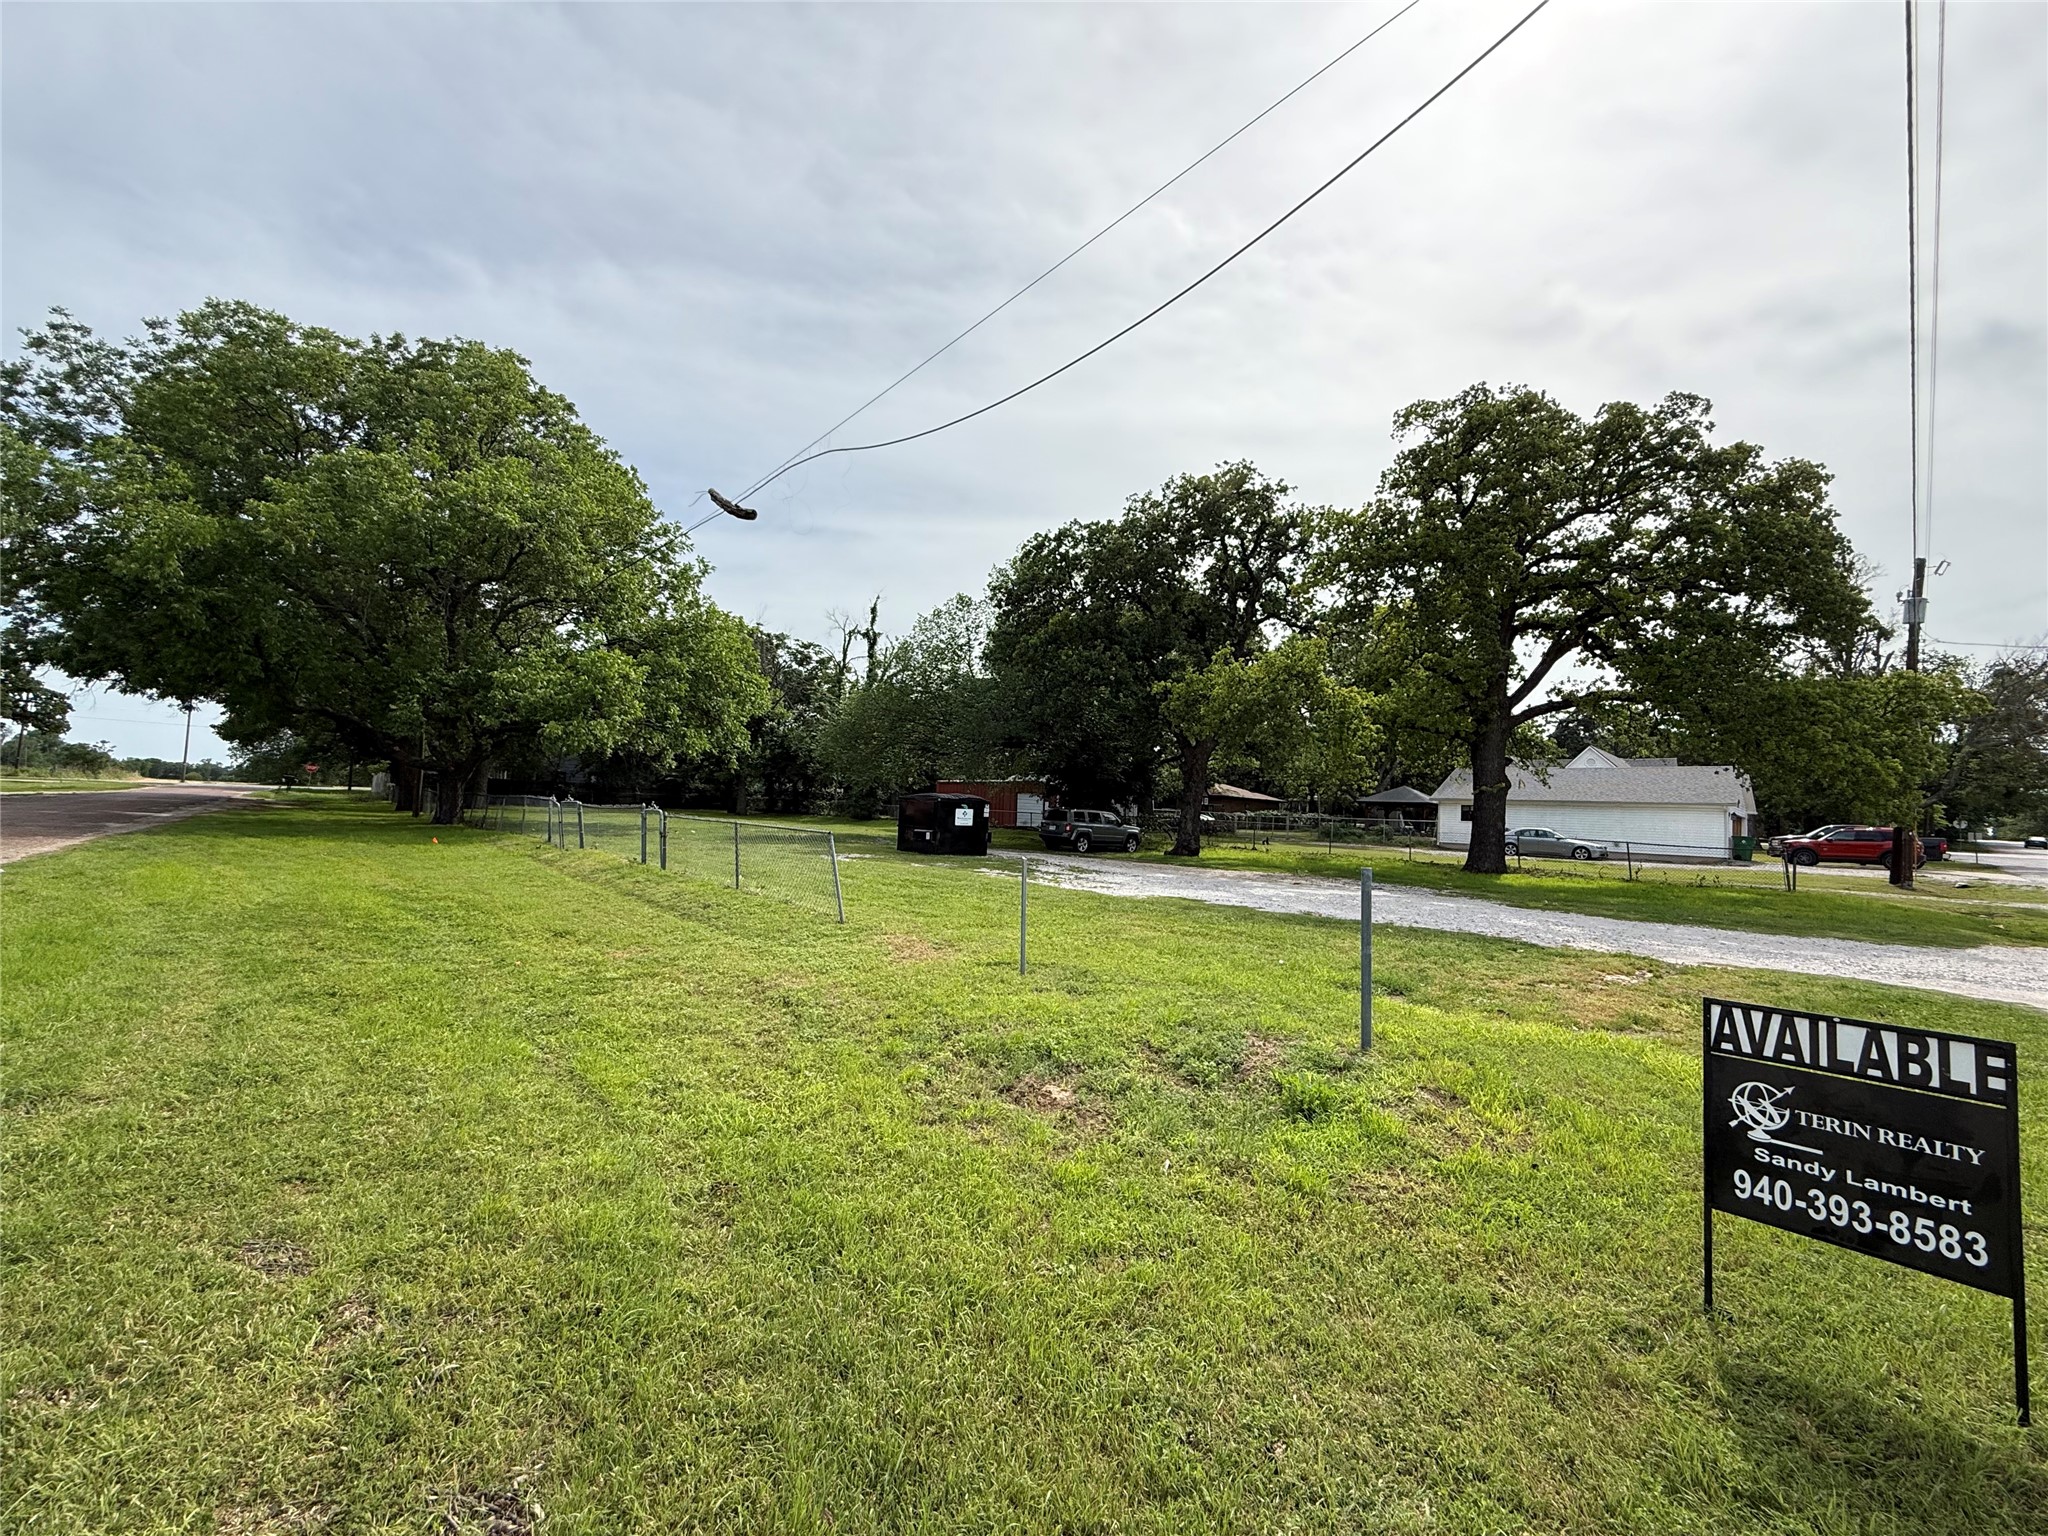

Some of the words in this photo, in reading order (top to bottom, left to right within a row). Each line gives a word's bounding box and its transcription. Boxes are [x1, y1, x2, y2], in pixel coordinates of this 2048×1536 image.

[1710, 1004, 2007, 1096] AVAILABLE
[1795, 1110, 1871, 1141] TERIN
[1878, 1128, 1985, 1166] REALTY
[1733, 1169, 1989, 1267] 940-393-8583
[1754, 1148, 1836, 1182] Sandy
[1846, 1169, 1973, 1215] Lambert
